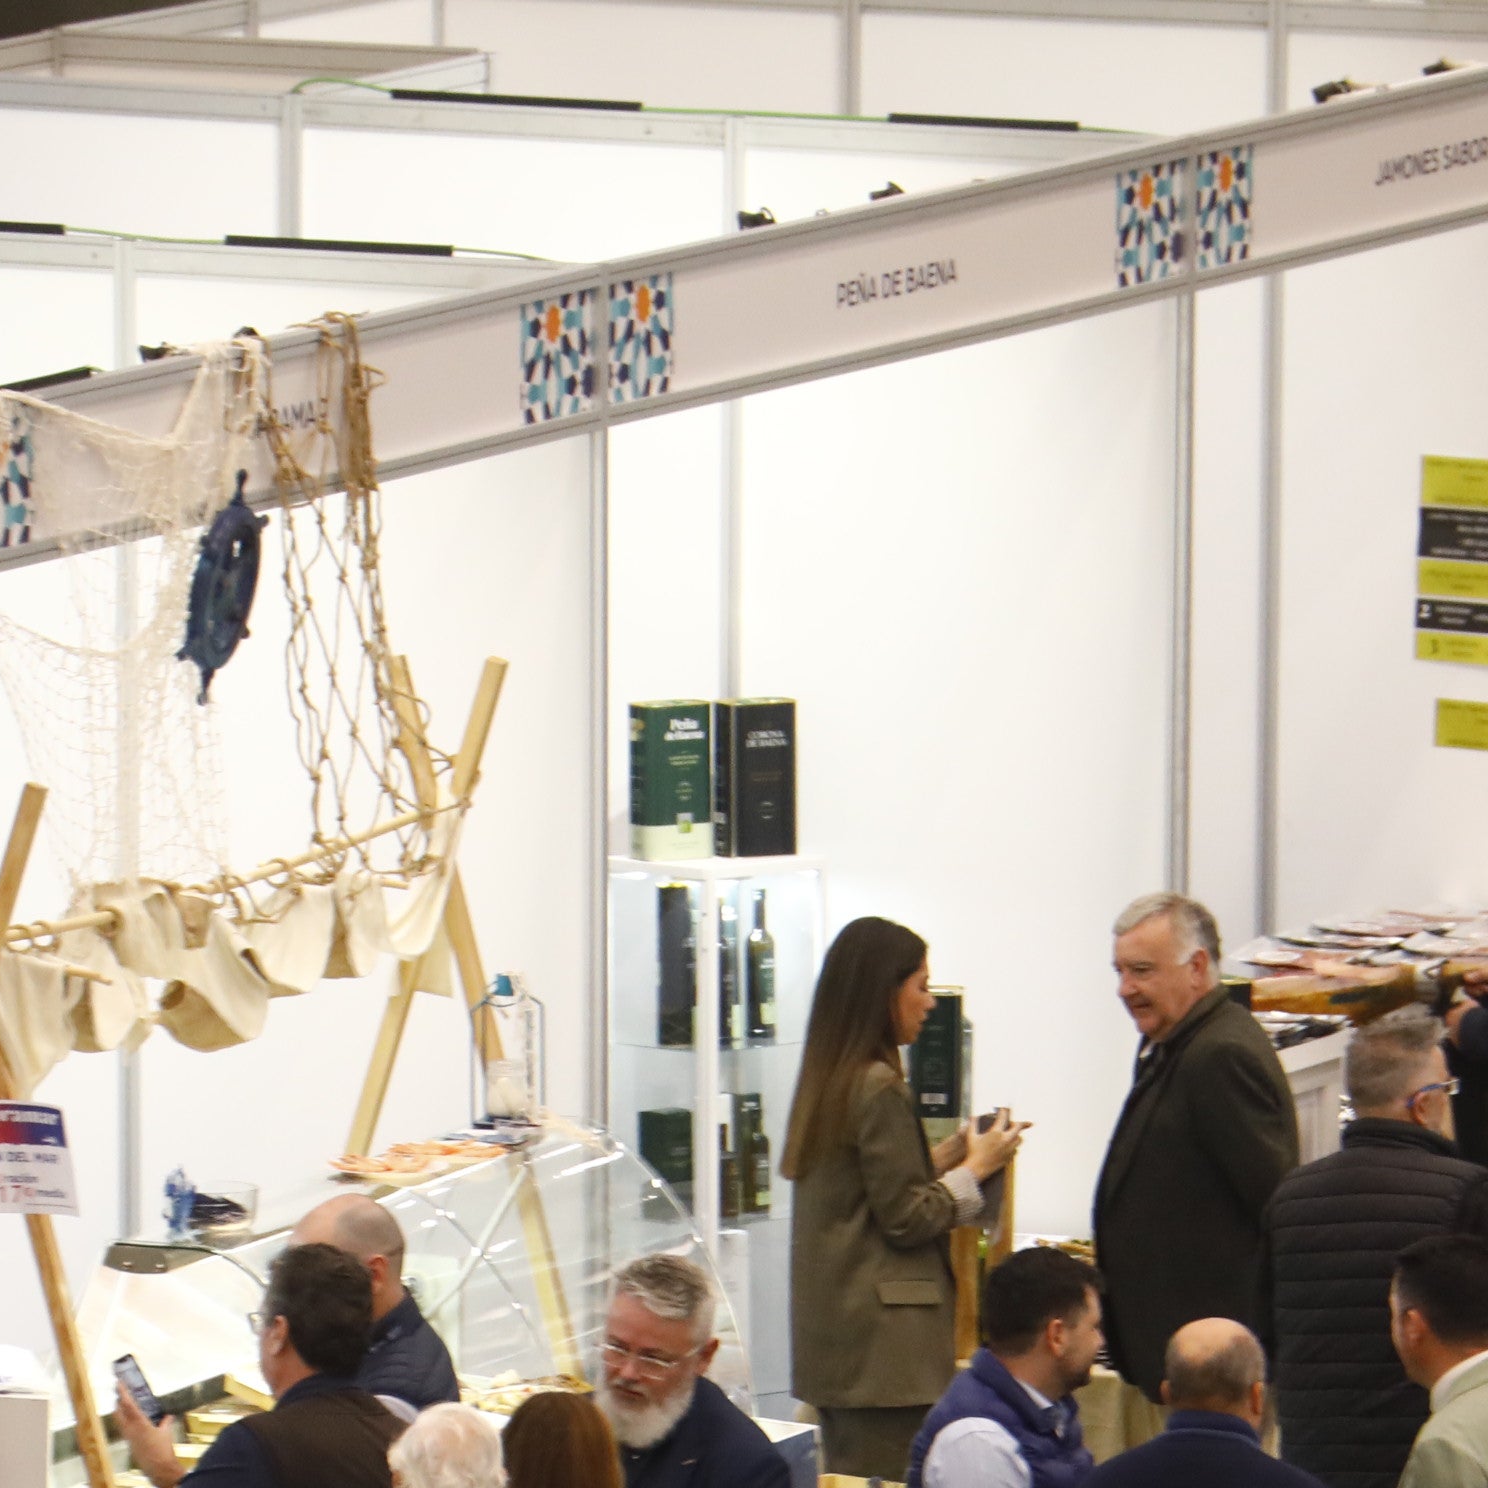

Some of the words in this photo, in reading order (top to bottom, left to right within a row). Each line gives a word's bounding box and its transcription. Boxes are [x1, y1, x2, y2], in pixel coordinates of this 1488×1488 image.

[1442, 136, 1488, 171] SABOR
[882, 270, 902, 298] DE
[905, 258, 957, 294] BAENA
